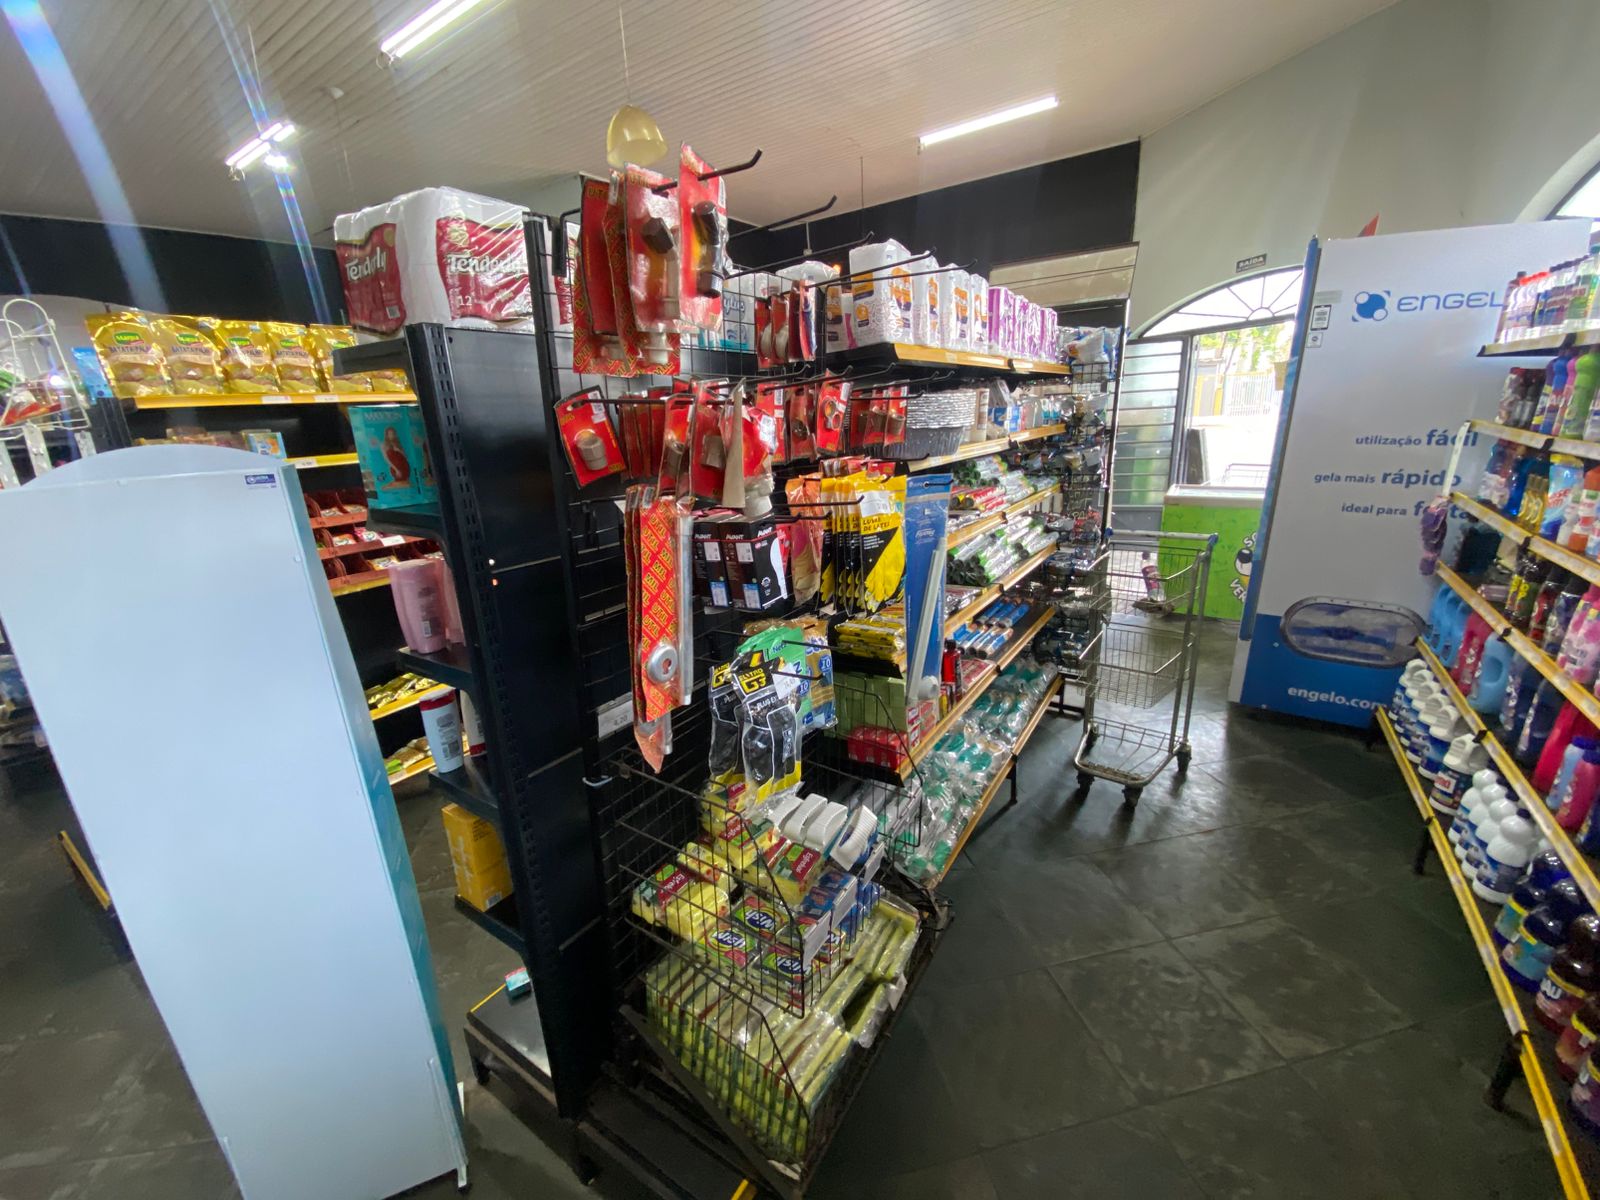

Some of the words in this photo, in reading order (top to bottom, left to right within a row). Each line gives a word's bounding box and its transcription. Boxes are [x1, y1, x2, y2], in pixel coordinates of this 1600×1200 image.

[1355, 435, 1422, 448] utilização
[1426, 429, 1478, 447] fáil
[1314, 472, 1341, 484] gela
[1344, 473, 1376, 483] mais
[1341, 502, 1374, 514] ideal
[1376, 507, 1407, 516] para
[745, 910, 775, 931] Wish
